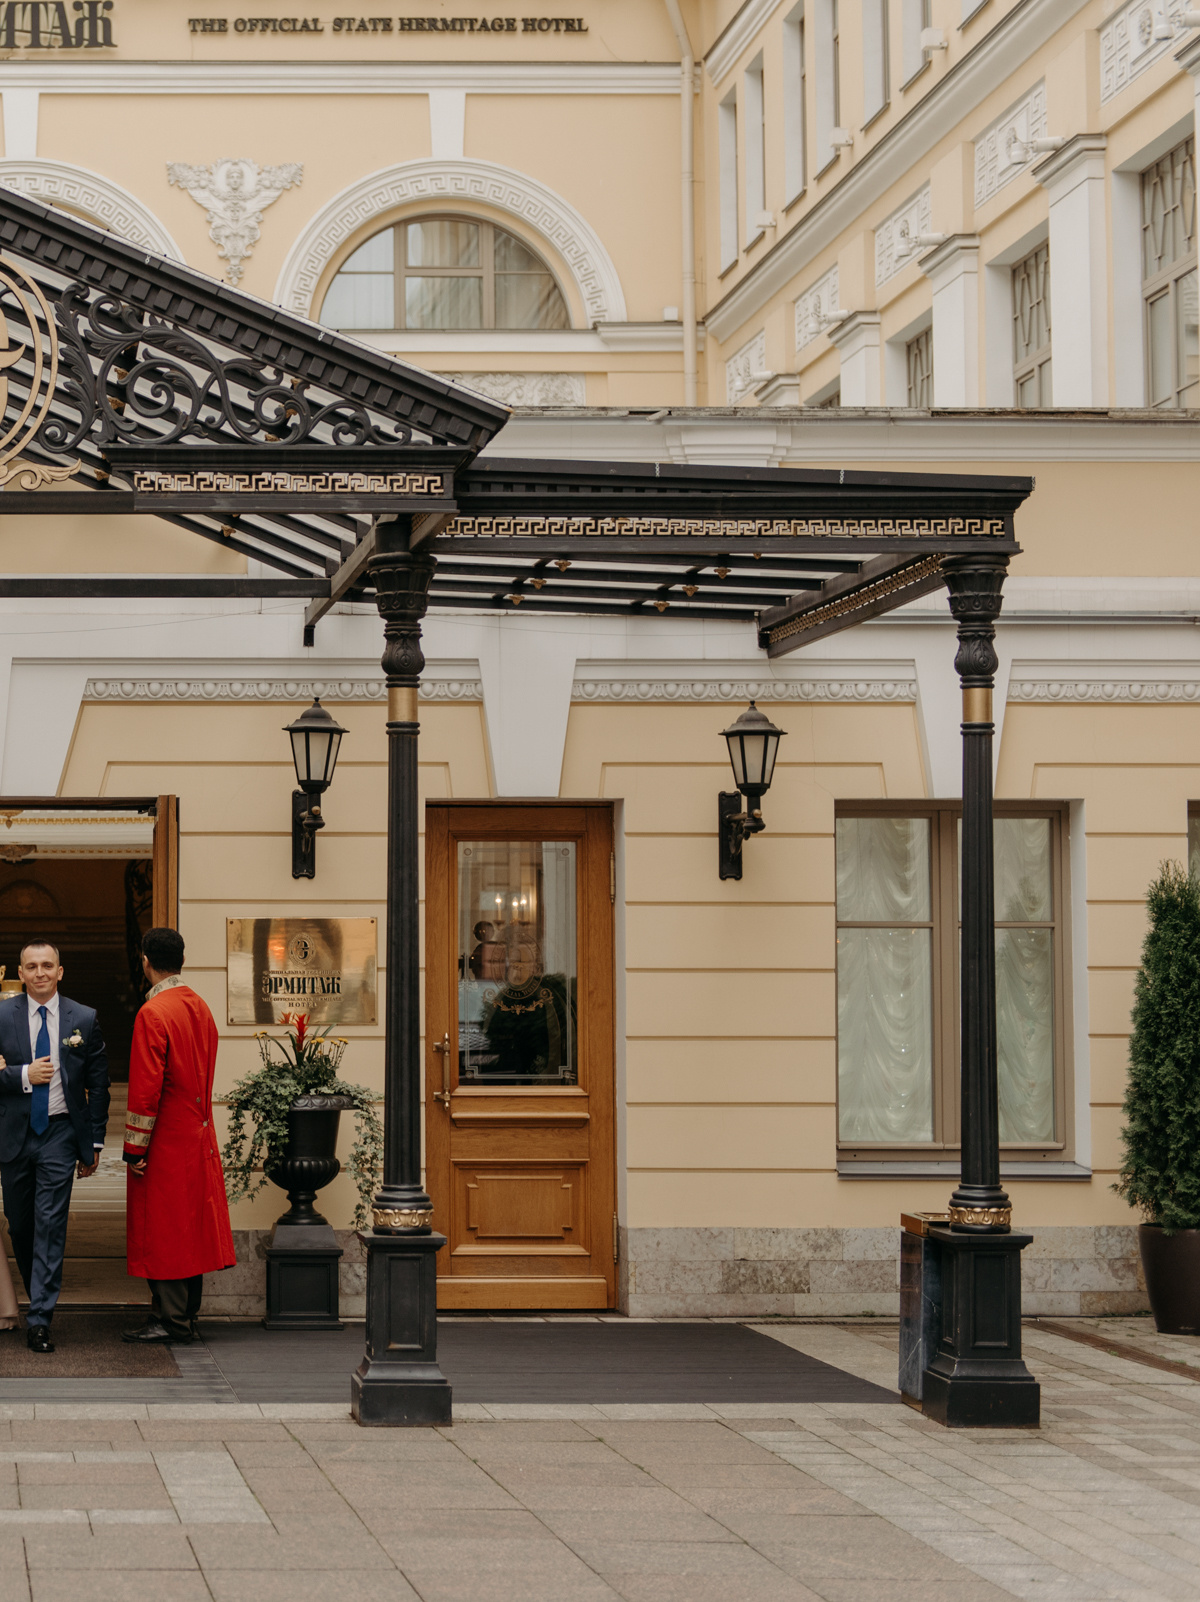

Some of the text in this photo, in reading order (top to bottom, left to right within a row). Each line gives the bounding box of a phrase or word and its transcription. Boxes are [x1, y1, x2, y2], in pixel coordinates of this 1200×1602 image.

[188, 17, 588, 34] THE OFFICIAL STATE HERMITAGE HOTEL
[262, 976, 341, 994] ЭРМИТАЖ
